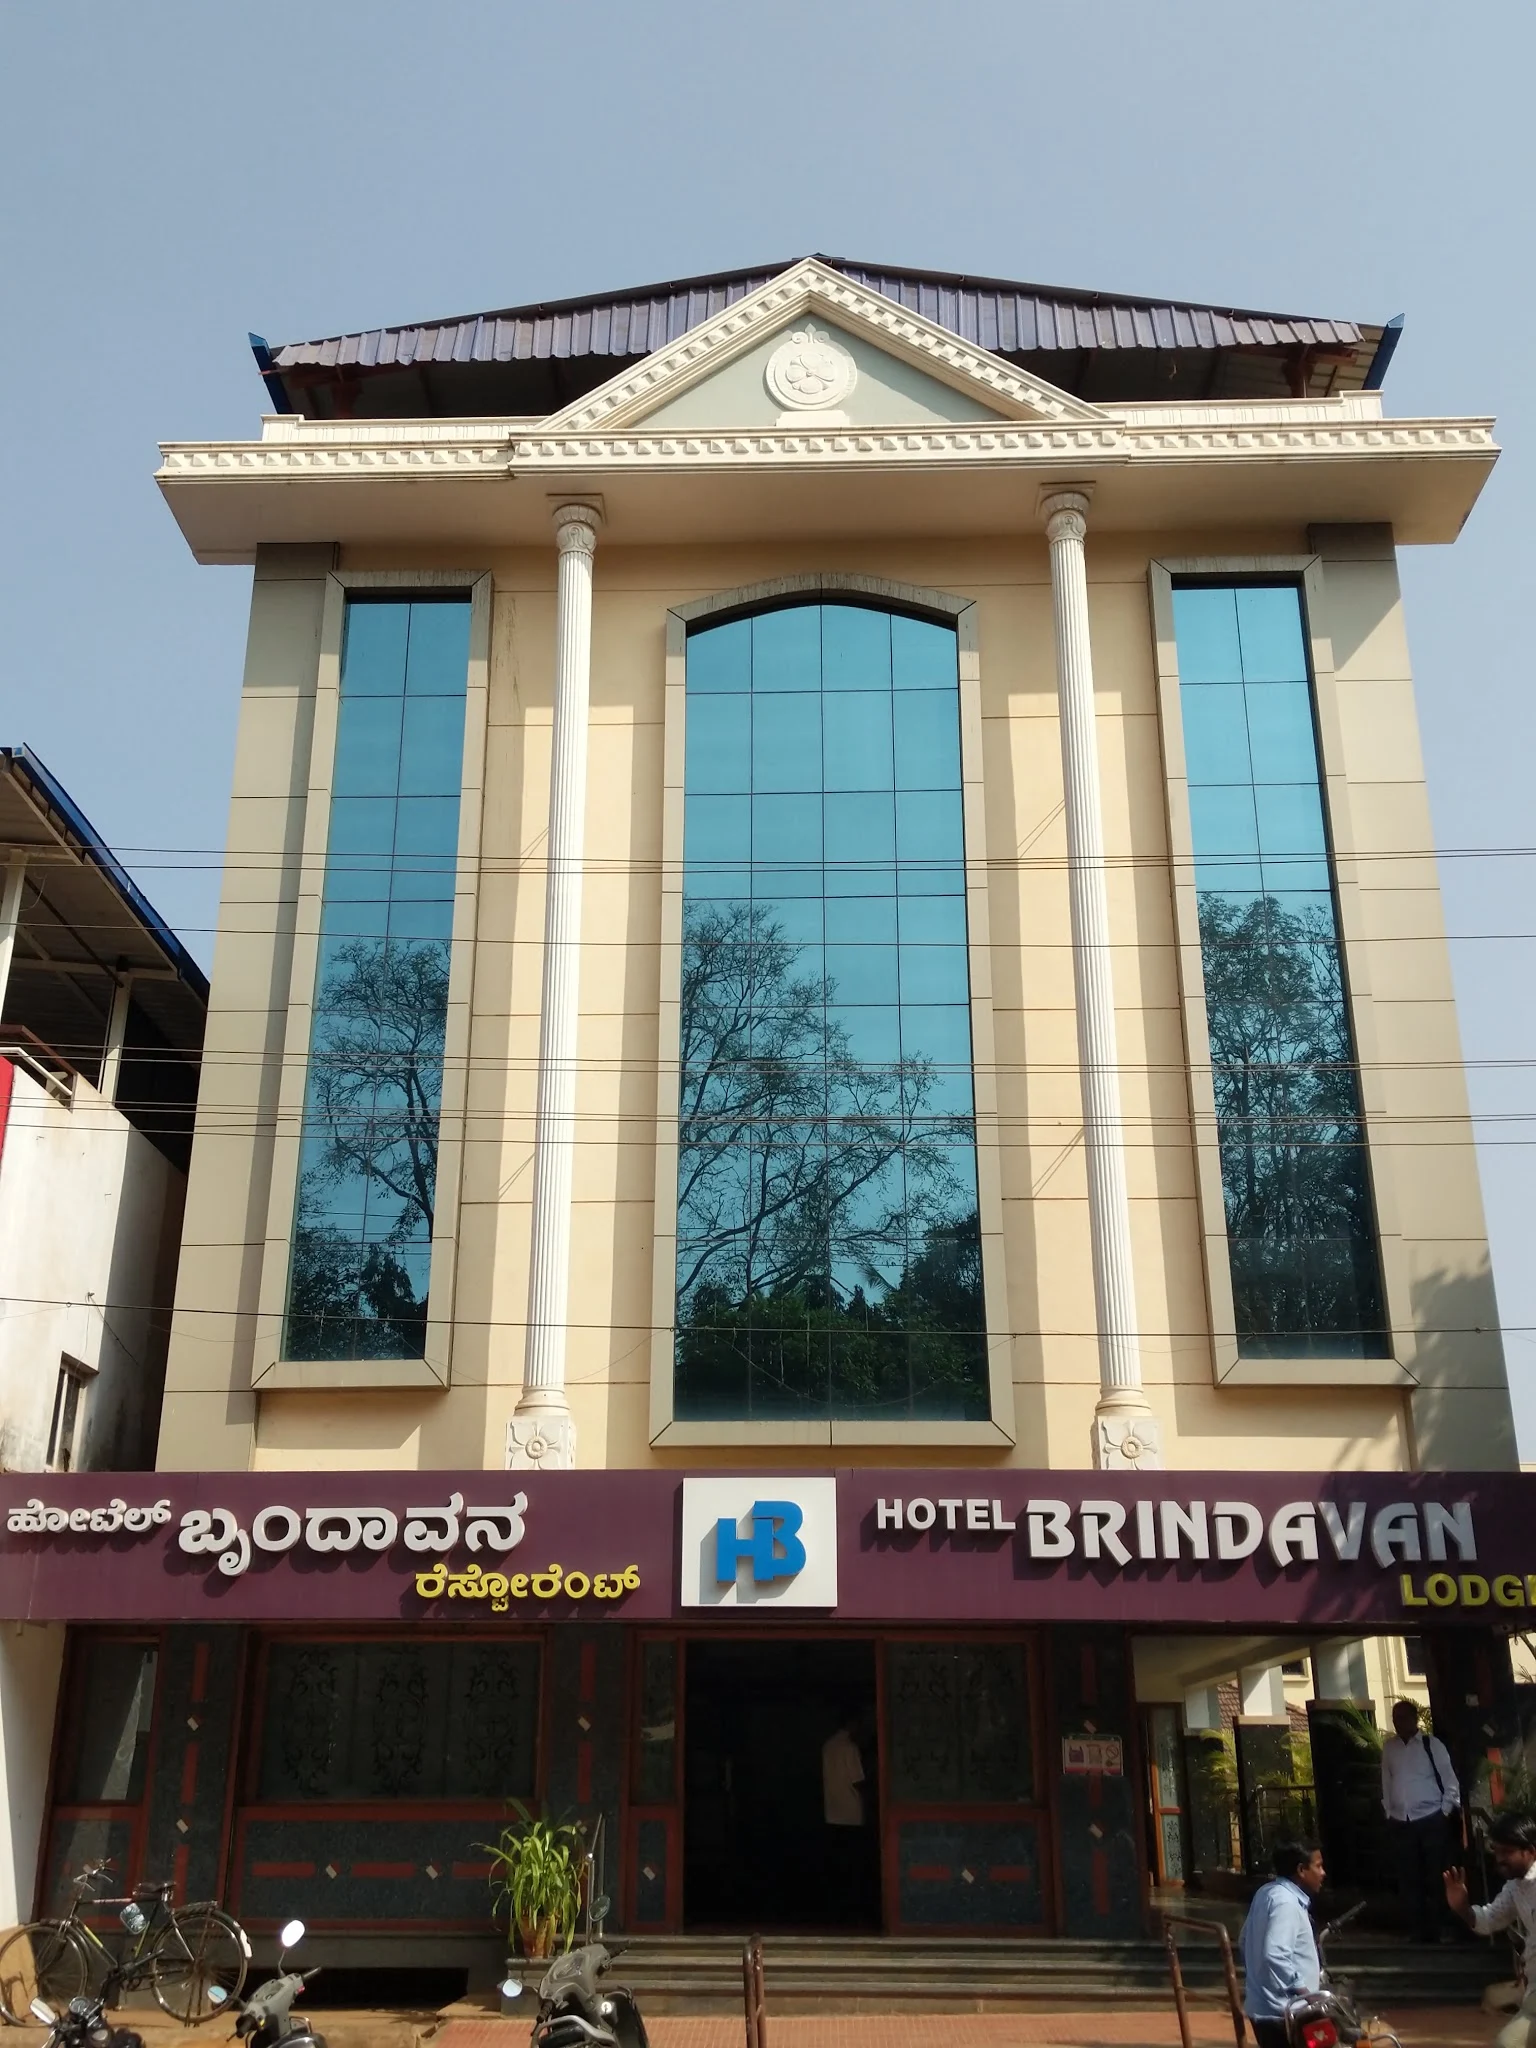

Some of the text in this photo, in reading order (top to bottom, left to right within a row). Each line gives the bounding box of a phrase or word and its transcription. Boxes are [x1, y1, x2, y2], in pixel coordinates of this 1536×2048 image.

[7, 1491, 528, 1576] ಹೋಟೆಲ್ ಬೃಂದಾವನ
[717, 1500, 807, 1582] HB
[876, 1498, 1478, 1569] HOTEL BRINDAVAN
[415, 1563, 641, 1611] ರೆಸ್ಟೋರೆಂಟ್
